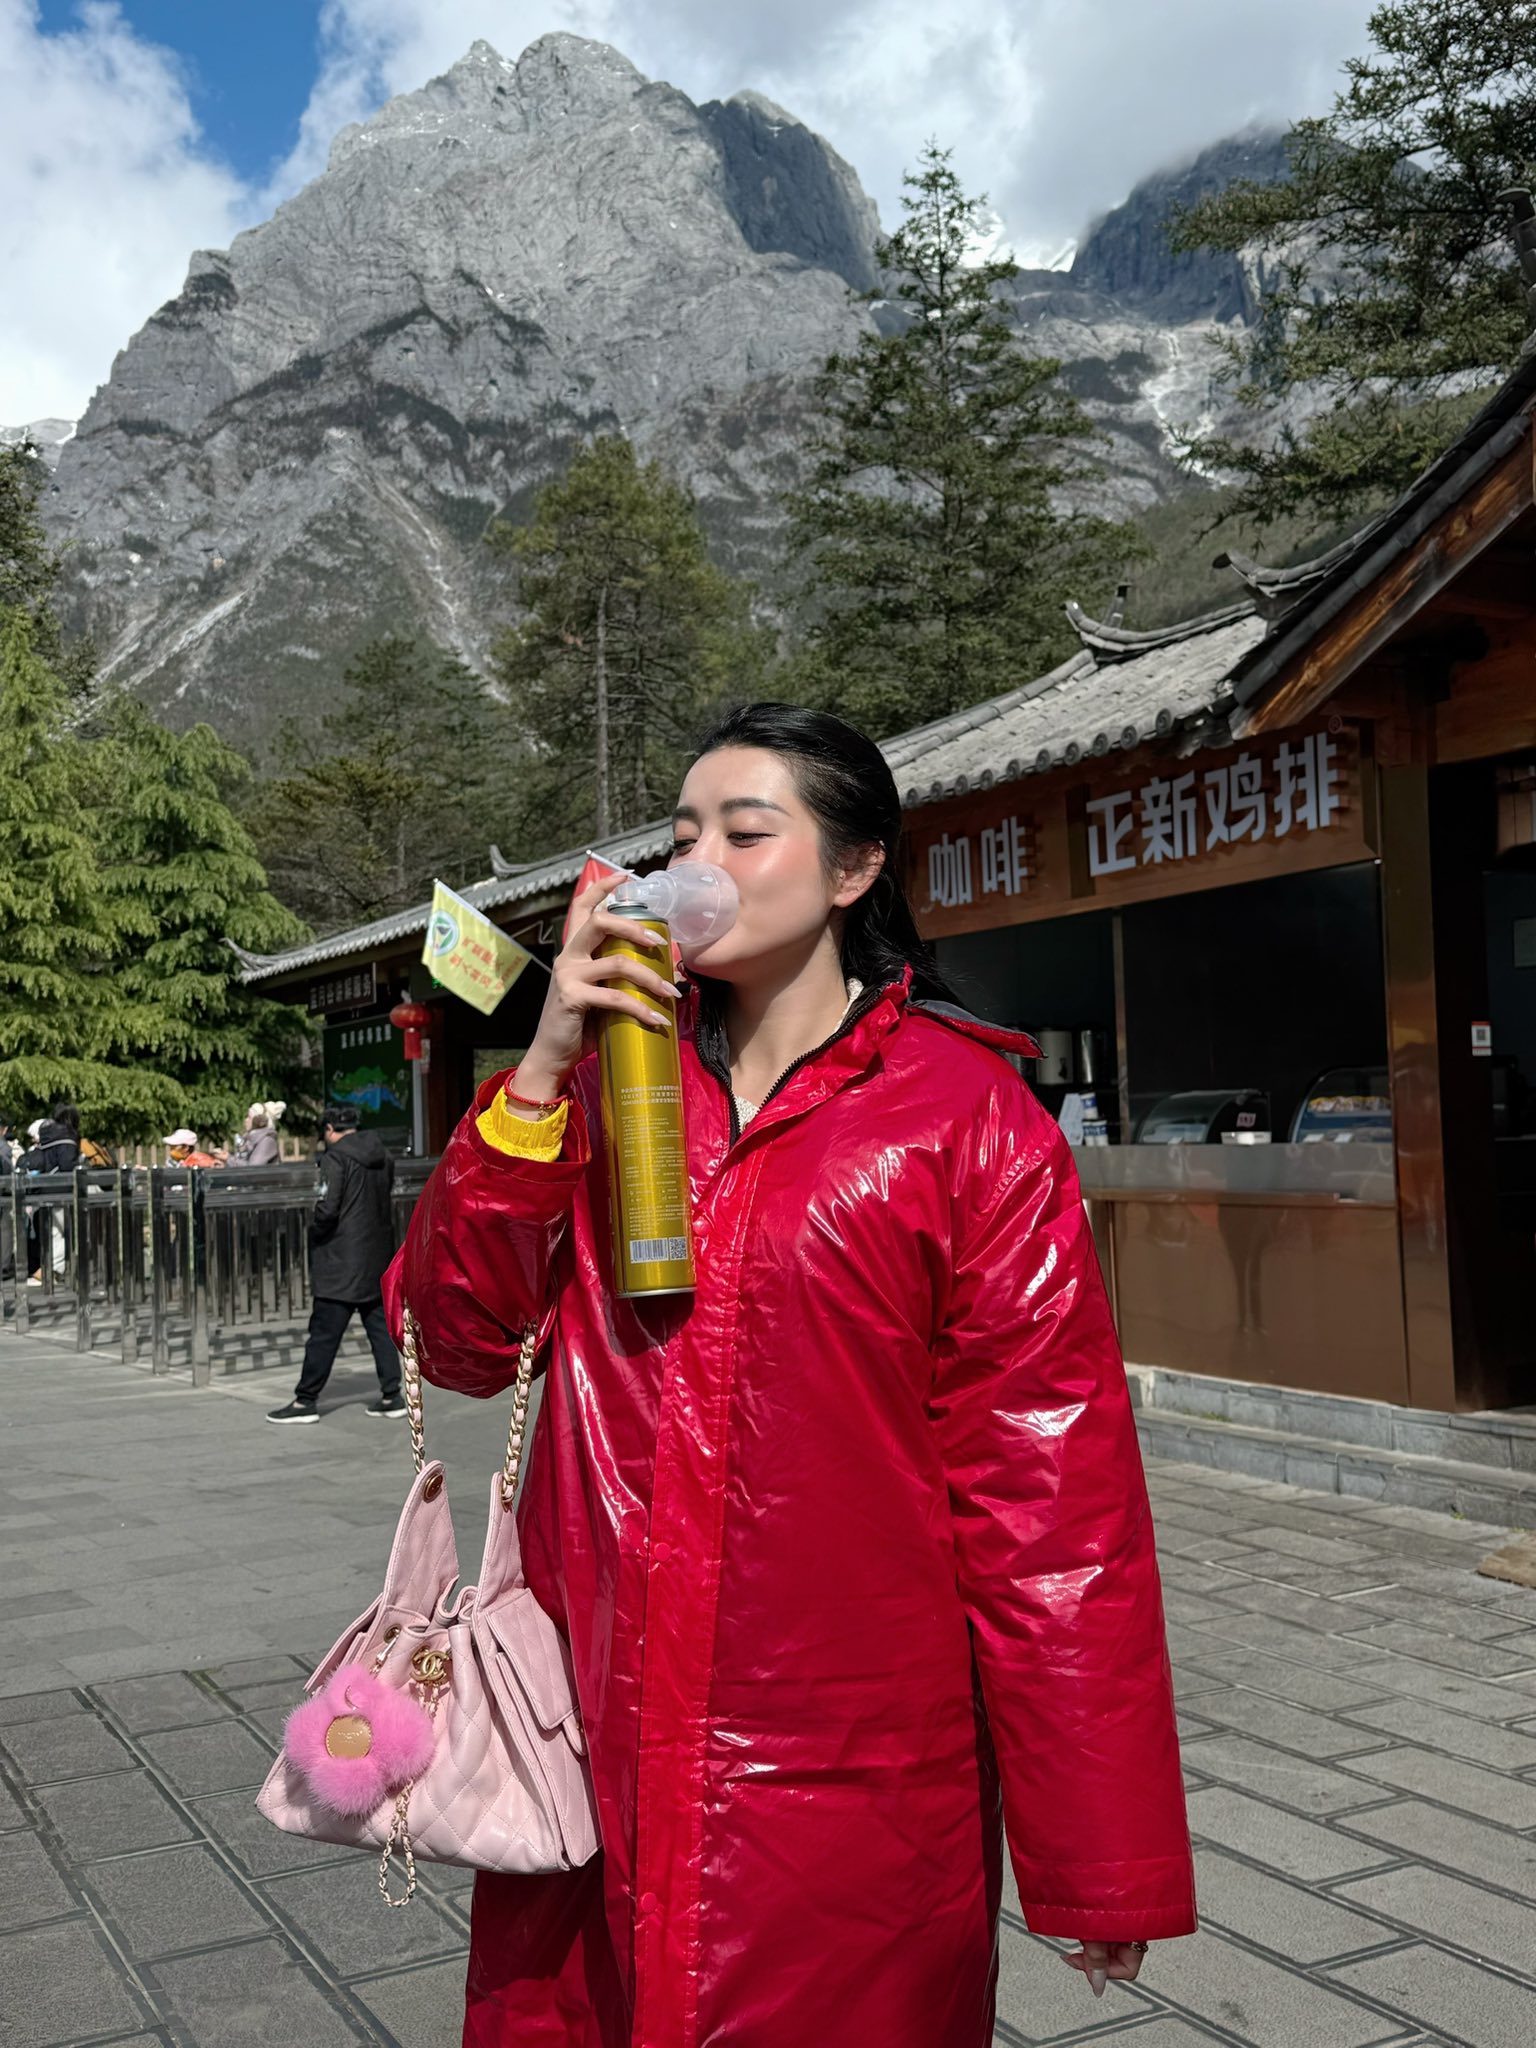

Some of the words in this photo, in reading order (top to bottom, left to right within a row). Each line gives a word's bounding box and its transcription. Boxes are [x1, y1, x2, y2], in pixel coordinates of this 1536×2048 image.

[928, 815, 1029, 908] 咖啡
[1086, 732, 1340, 877] 正新鸡排
